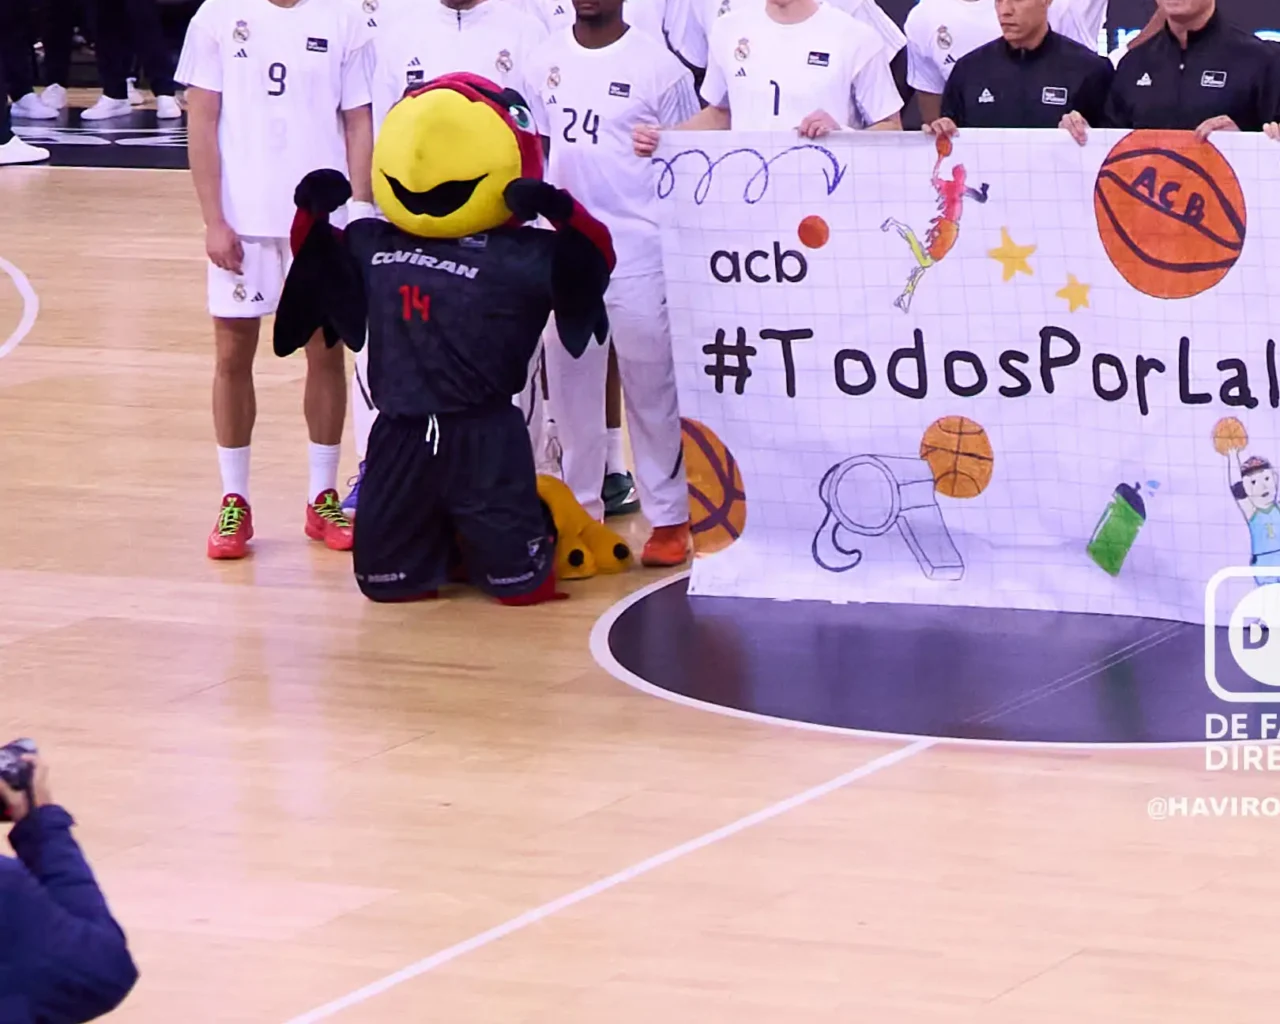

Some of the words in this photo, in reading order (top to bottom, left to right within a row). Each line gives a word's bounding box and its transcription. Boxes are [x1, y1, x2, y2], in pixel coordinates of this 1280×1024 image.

[267, 62, 287, 96] 9
[770, 79, 780, 116] 1
[562, 107, 599, 144] 24
[1131, 166, 1206, 225] ACB
[710, 240, 808, 284] acb
[399, 284, 431, 321] 14
